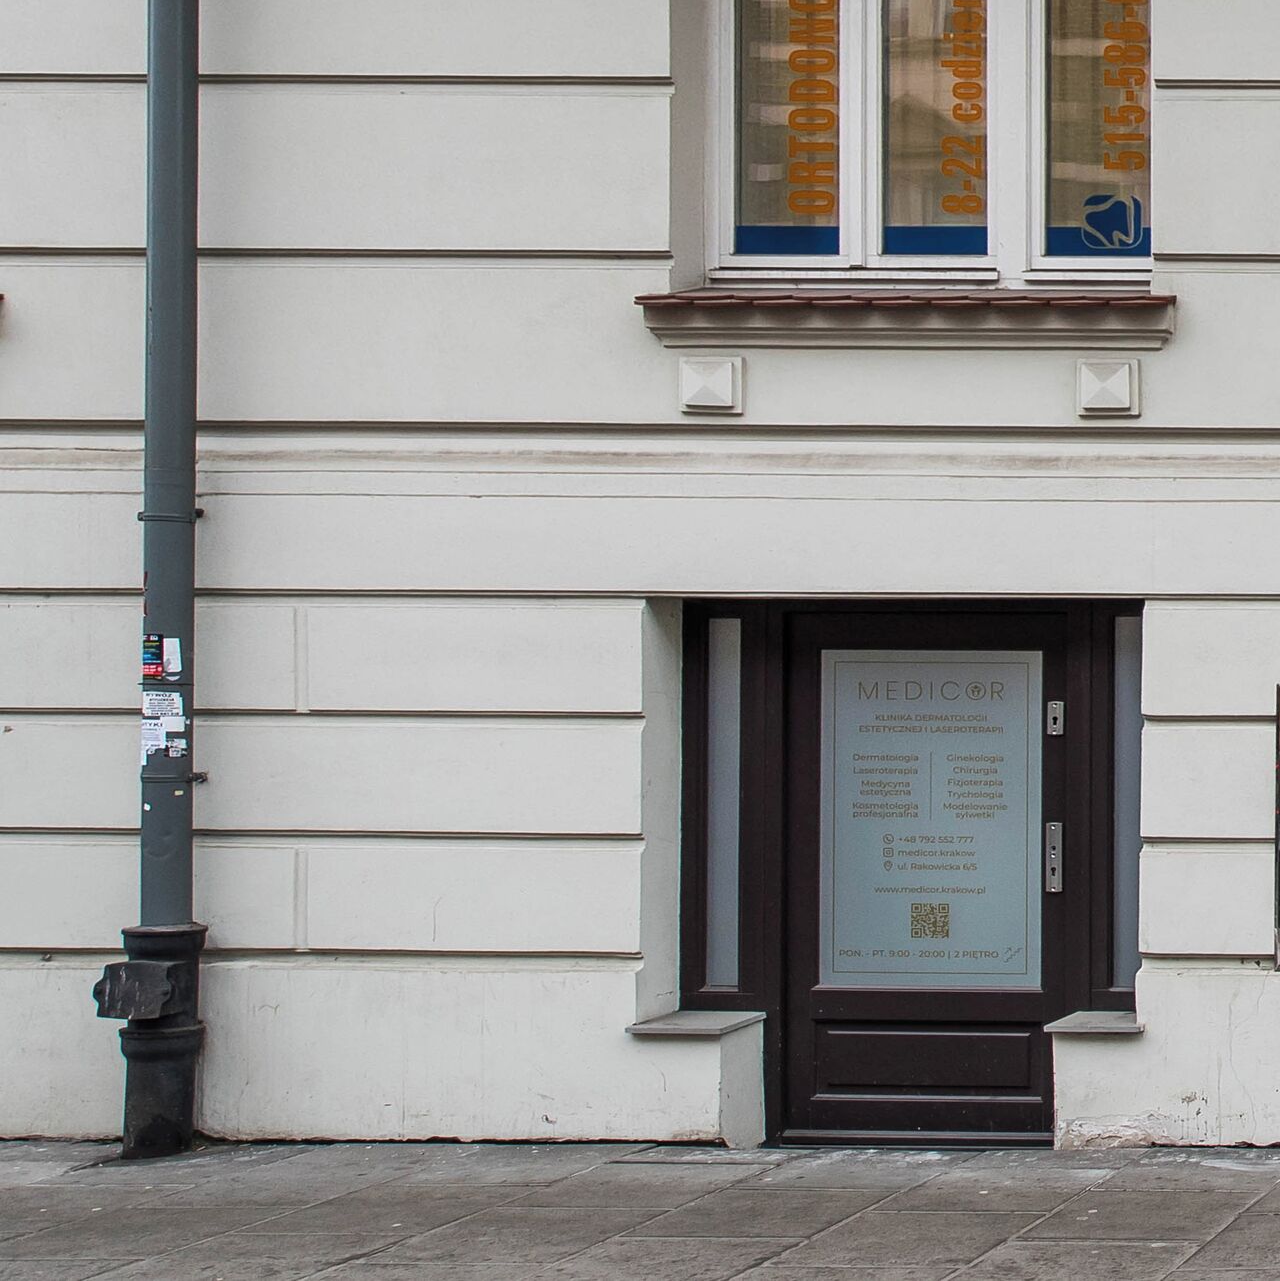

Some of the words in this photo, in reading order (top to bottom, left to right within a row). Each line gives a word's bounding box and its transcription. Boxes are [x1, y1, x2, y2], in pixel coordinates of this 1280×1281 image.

[941, 135, 984, 215] 8-22
[858, 681, 1005, 700] MEDICOR
[875, 714, 913, 722] KLINIKA
[914, 714, 988, 722] DERMATOLOGII
[930, 726, 1003, 734] LASEROTERAPII
[853, 753, 919, 763] Dermatologia
[946, 754, 1004, 763] Ginekologia
[853, 766, 918, 776] Laseroterapia
[953, 766, 998, 776] Chirurgia
[861, 780, 910, 789] Medycyna
[947, 778, 1003, 788] Fizjoterapia
[859, 789, 911, 797] estetyczna
[947, 790, 1003, 800] Trychologia
[852, 802, 919, 811] Kosmetologia
[943, 803, 1008, 811] Modelowanie
[852, 811, 918, 820] profesjonalna
[955, 810, 995, 820] sylwetki
[898, 848, 976, 857] medicor.krakow
[874, 886, 986, 894] www.medicor.krakow.pl
